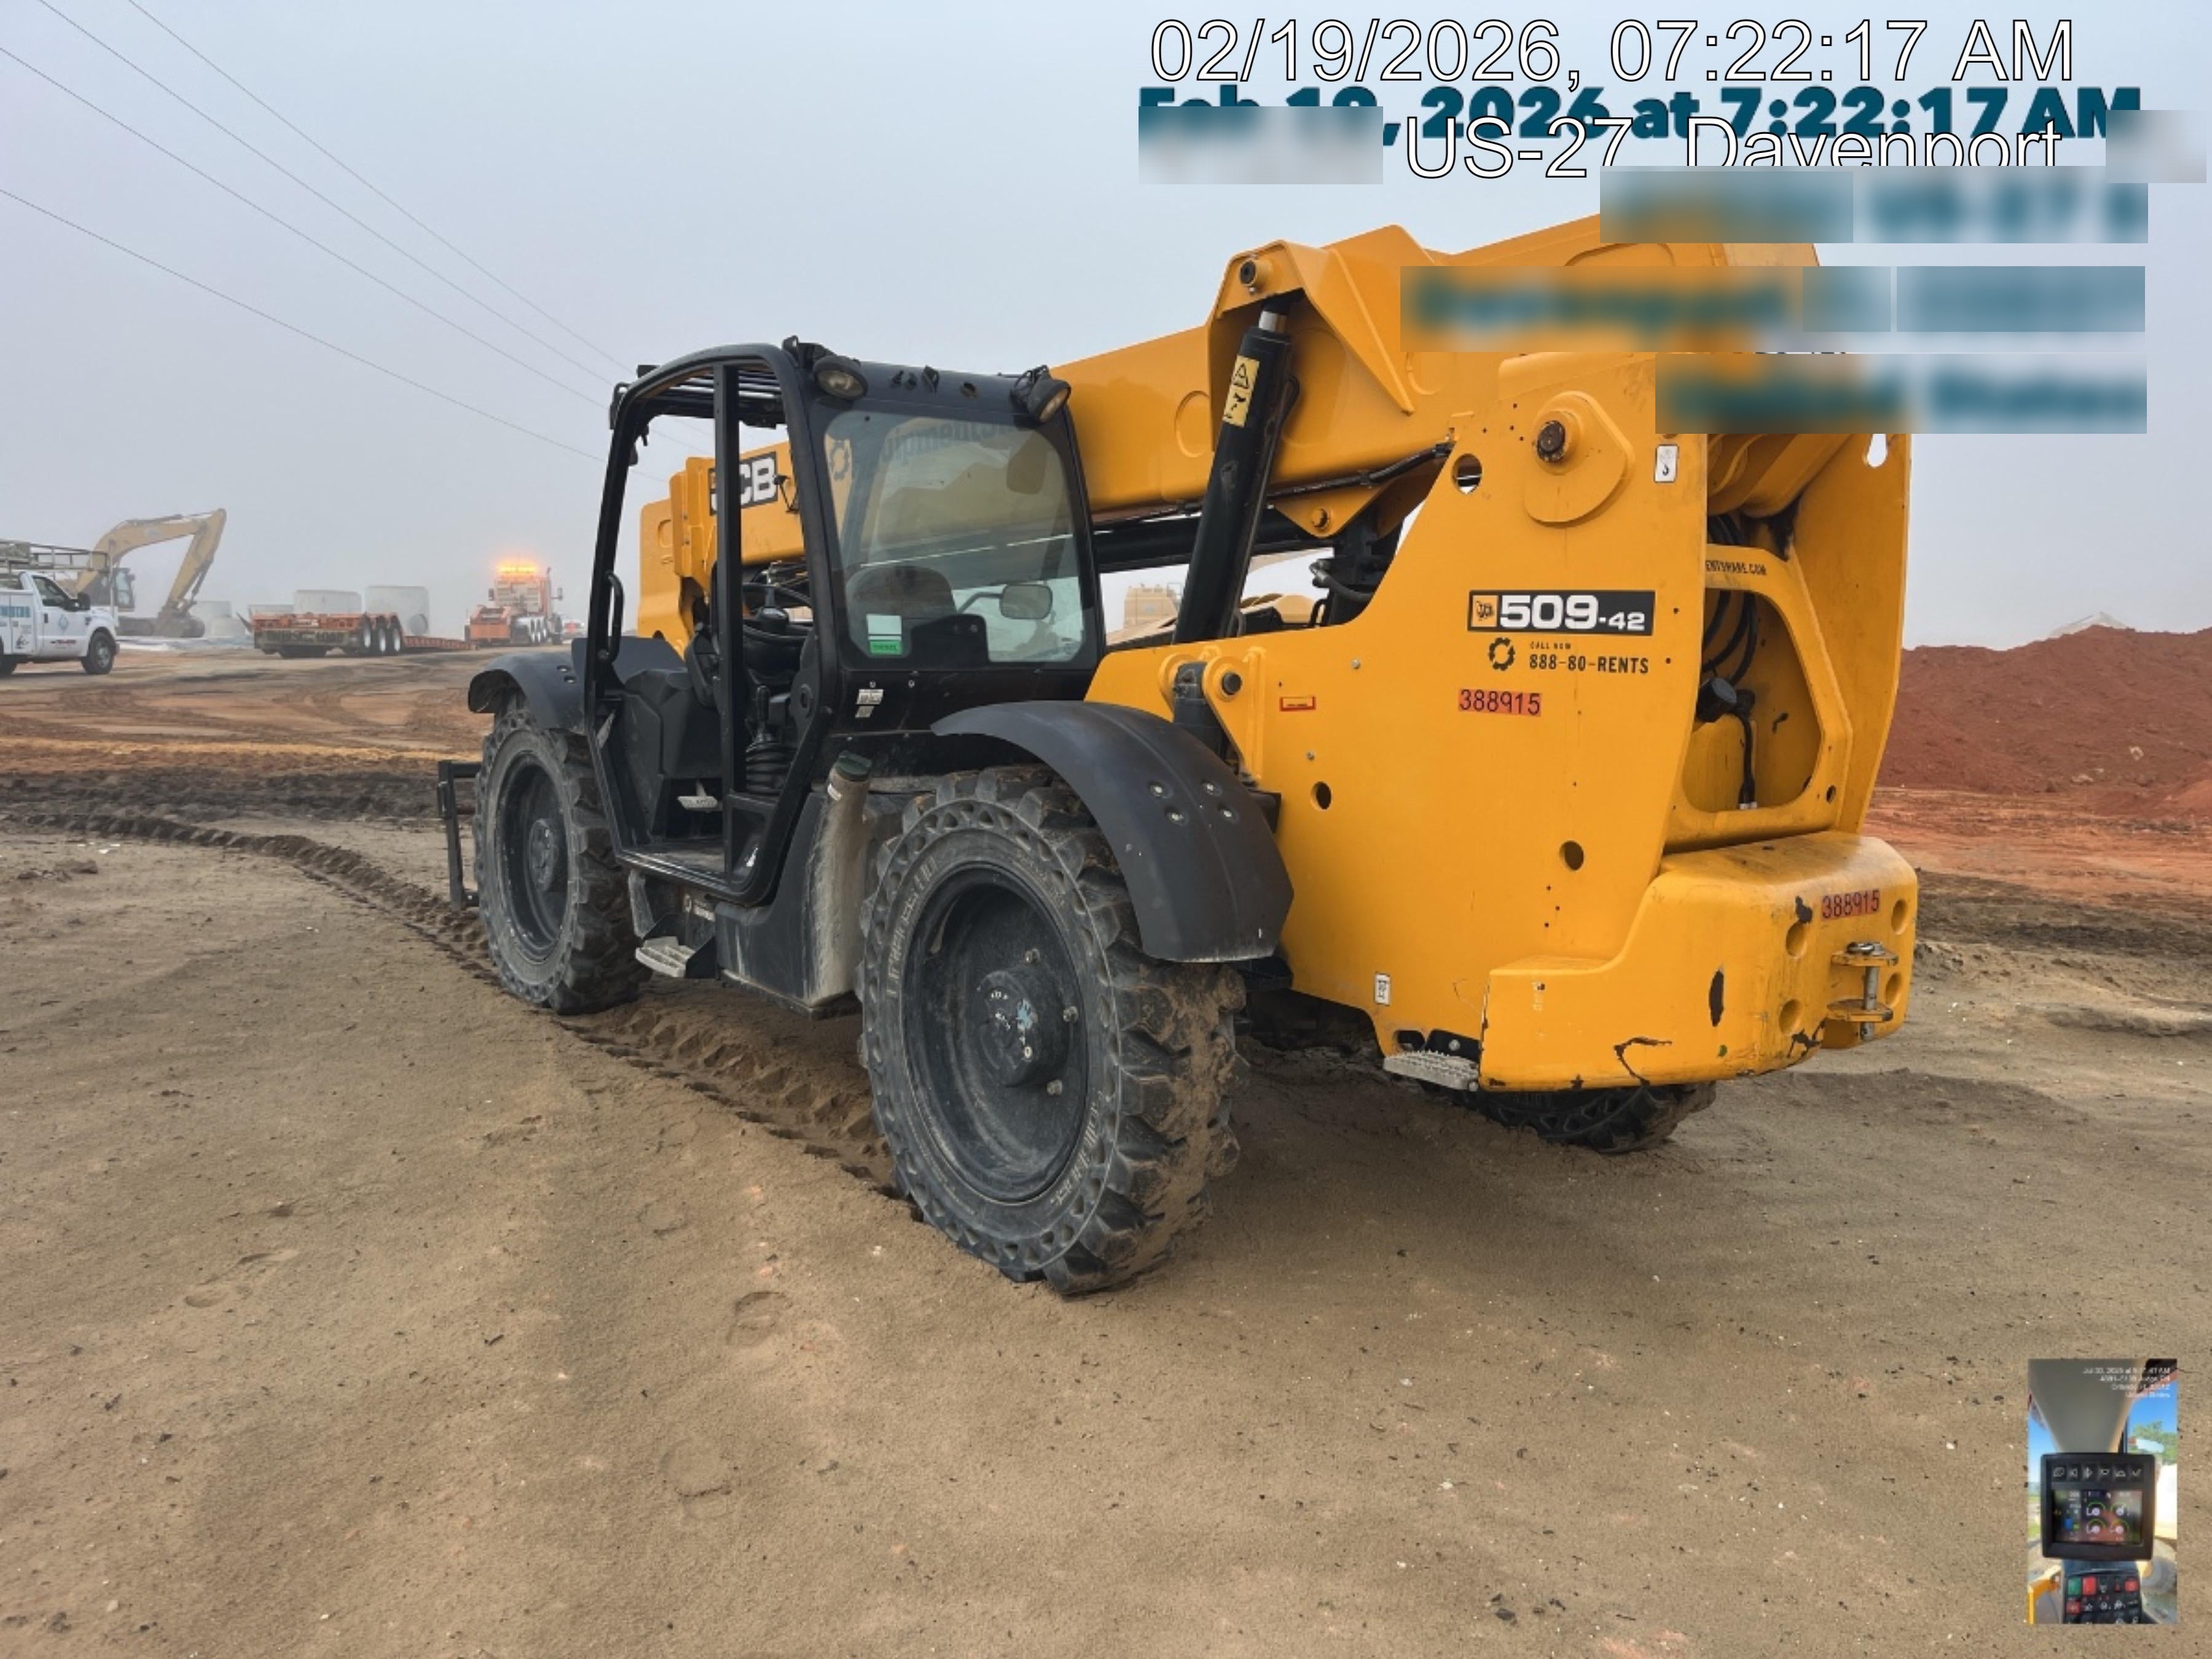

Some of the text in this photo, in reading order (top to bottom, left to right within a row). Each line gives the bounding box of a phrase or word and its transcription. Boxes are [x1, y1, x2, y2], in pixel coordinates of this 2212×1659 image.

[1499, 594, 1645, 631] 509-42
[1529, 654, 1649, 675] 888-80-RENTS
[1459, 688, 1541, 716] 388915
[1822, 888, 1880, 919] 388915
